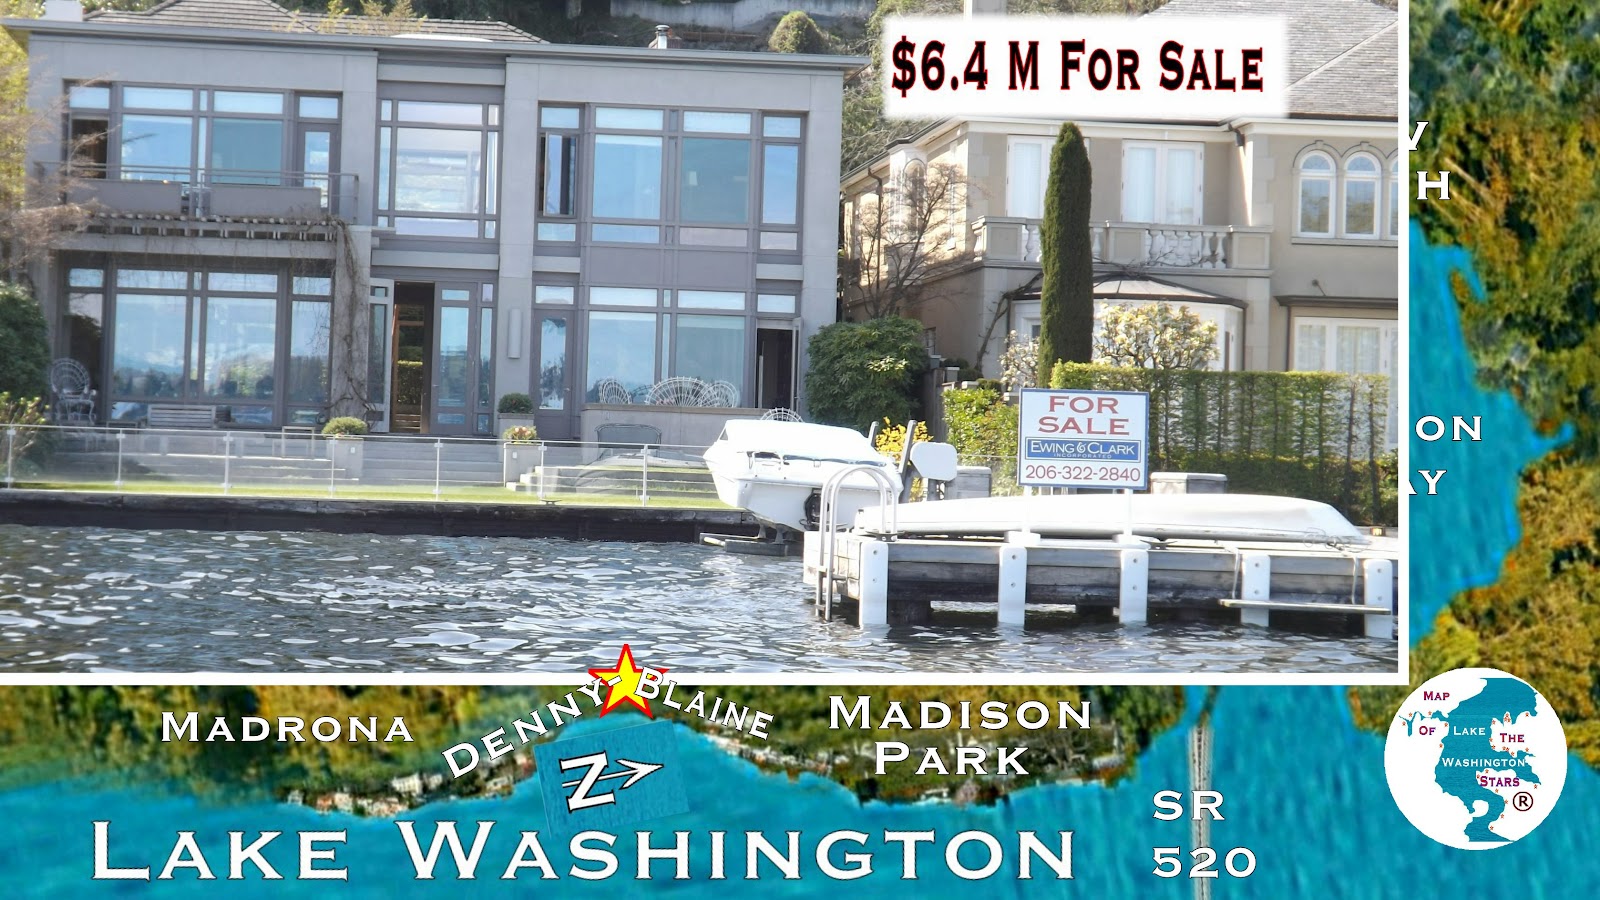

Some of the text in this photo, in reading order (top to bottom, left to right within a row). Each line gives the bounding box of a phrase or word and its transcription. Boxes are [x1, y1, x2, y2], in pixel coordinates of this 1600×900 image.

[1049, 395, 1119, 414] FOR
[1038, 416, 1130, 436] SALE
[1025, 464, 1141, 482] 206-322-2840
